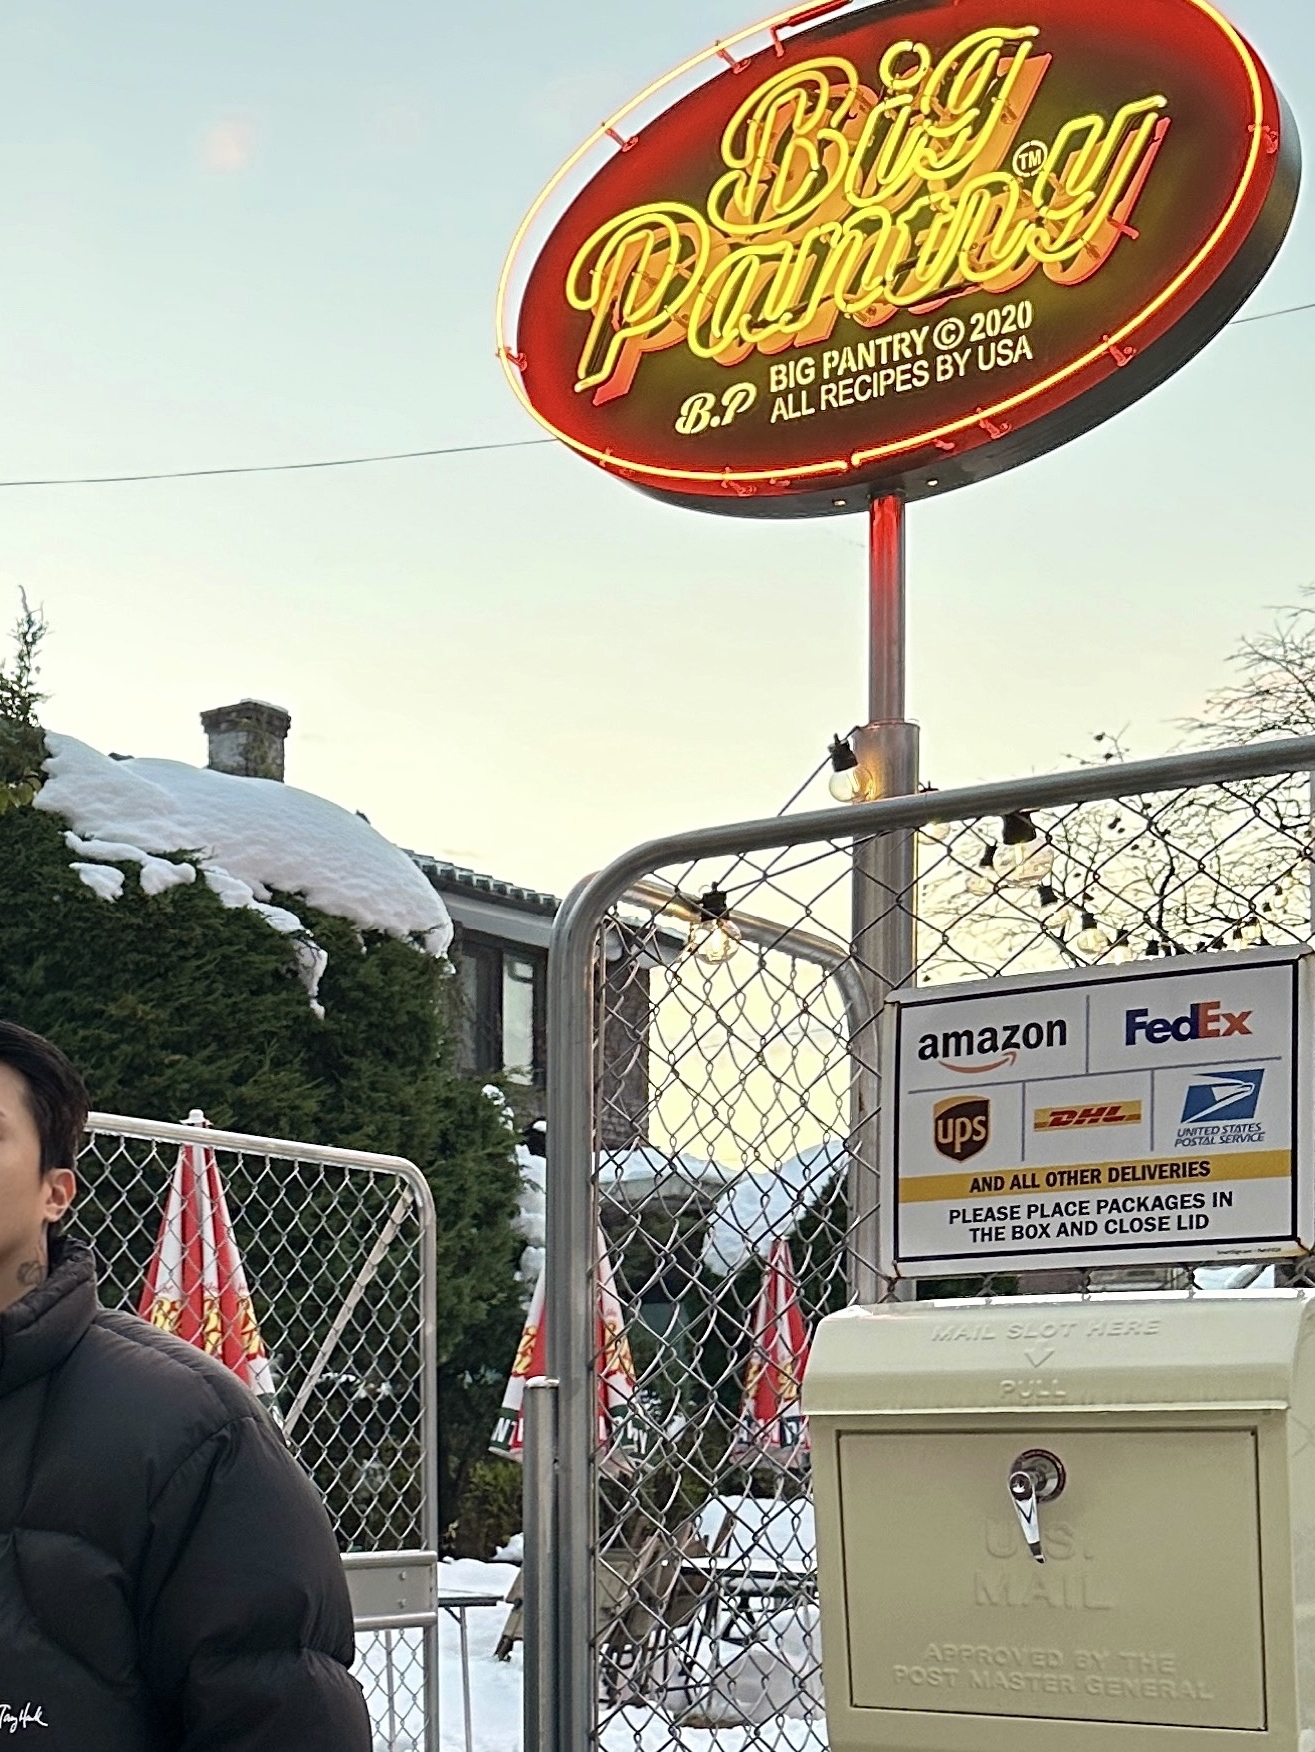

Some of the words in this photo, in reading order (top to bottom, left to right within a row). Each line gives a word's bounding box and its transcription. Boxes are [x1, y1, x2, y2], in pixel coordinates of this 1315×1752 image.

[707, 25, 1045, 236] Big
[566, 95, 1168, 393] Pantry
[769, 357, 816, 393] BIG
[822, 326, 929, 380] PANTRY
[969, 300, 1033, 341] 2020
[770, 396, 816, 424] ALL
[820, 363, 930, 411] RECIPES
[936, 349, 972, 382] BY
[978, 334, 1034, 372] USA
[918, 1018, 1067, 1061] amazon
[1125, 1001, 1253, 1046] FedEx
[936, 1114, 987, 1154] ups
[1048, 1105, 1130, 1127] DHL
[1177, 1126, 1220, 1138] UNITED
[1222, 1122, 1262, 1135] STATES
[1175, 1136, 1216, 1148] POSTAL
[1218, 1132, 1266, 1145] SERVICE
[969, 1175, 1005, 1194] AND
[1009, 1172, 1040, 1190] ALL
[1045, 1167, 1102, 1188] OTHER
[1108, 1160, 1212, 1183] DELIVERIES
[948, 1206, 1021, 1225] PLEASE
[1027, 1201, 1090, 1220] PLACE
[1096, 1193, 1206, 1216] PACKAGES
[1213, 1190, 1233, 1208] IN
[969, 1226, 1006, 1243] THE
[1011, 1222, 1051, 1241] BOX
[1056, 1219, 1099, 1238] AND
[1104, 1215, 1171, 1235] CLOSE
[1177, 1213, 1210, 1231] LID
[932, 1323, 996, 1342] MAIL
[1006, 1322, 1077, 1340] SLOT
[1086, 1319, 1161, 1338] HERE
[1000, 1379, 1067, 1398] PULL
[974, 1568, 1113, 1611] MAIL
[925, 1643, 1065, 1668] APPROVED
[1075, 1650, 1110, 1672] BY
[1118, 1652, 1178, 1675] THE
[892, 1664, 959, 1688] POST
[969, 1669, 1076, 1695] MASTER
[1086, 1674, 1215, 1701] GENERAL
